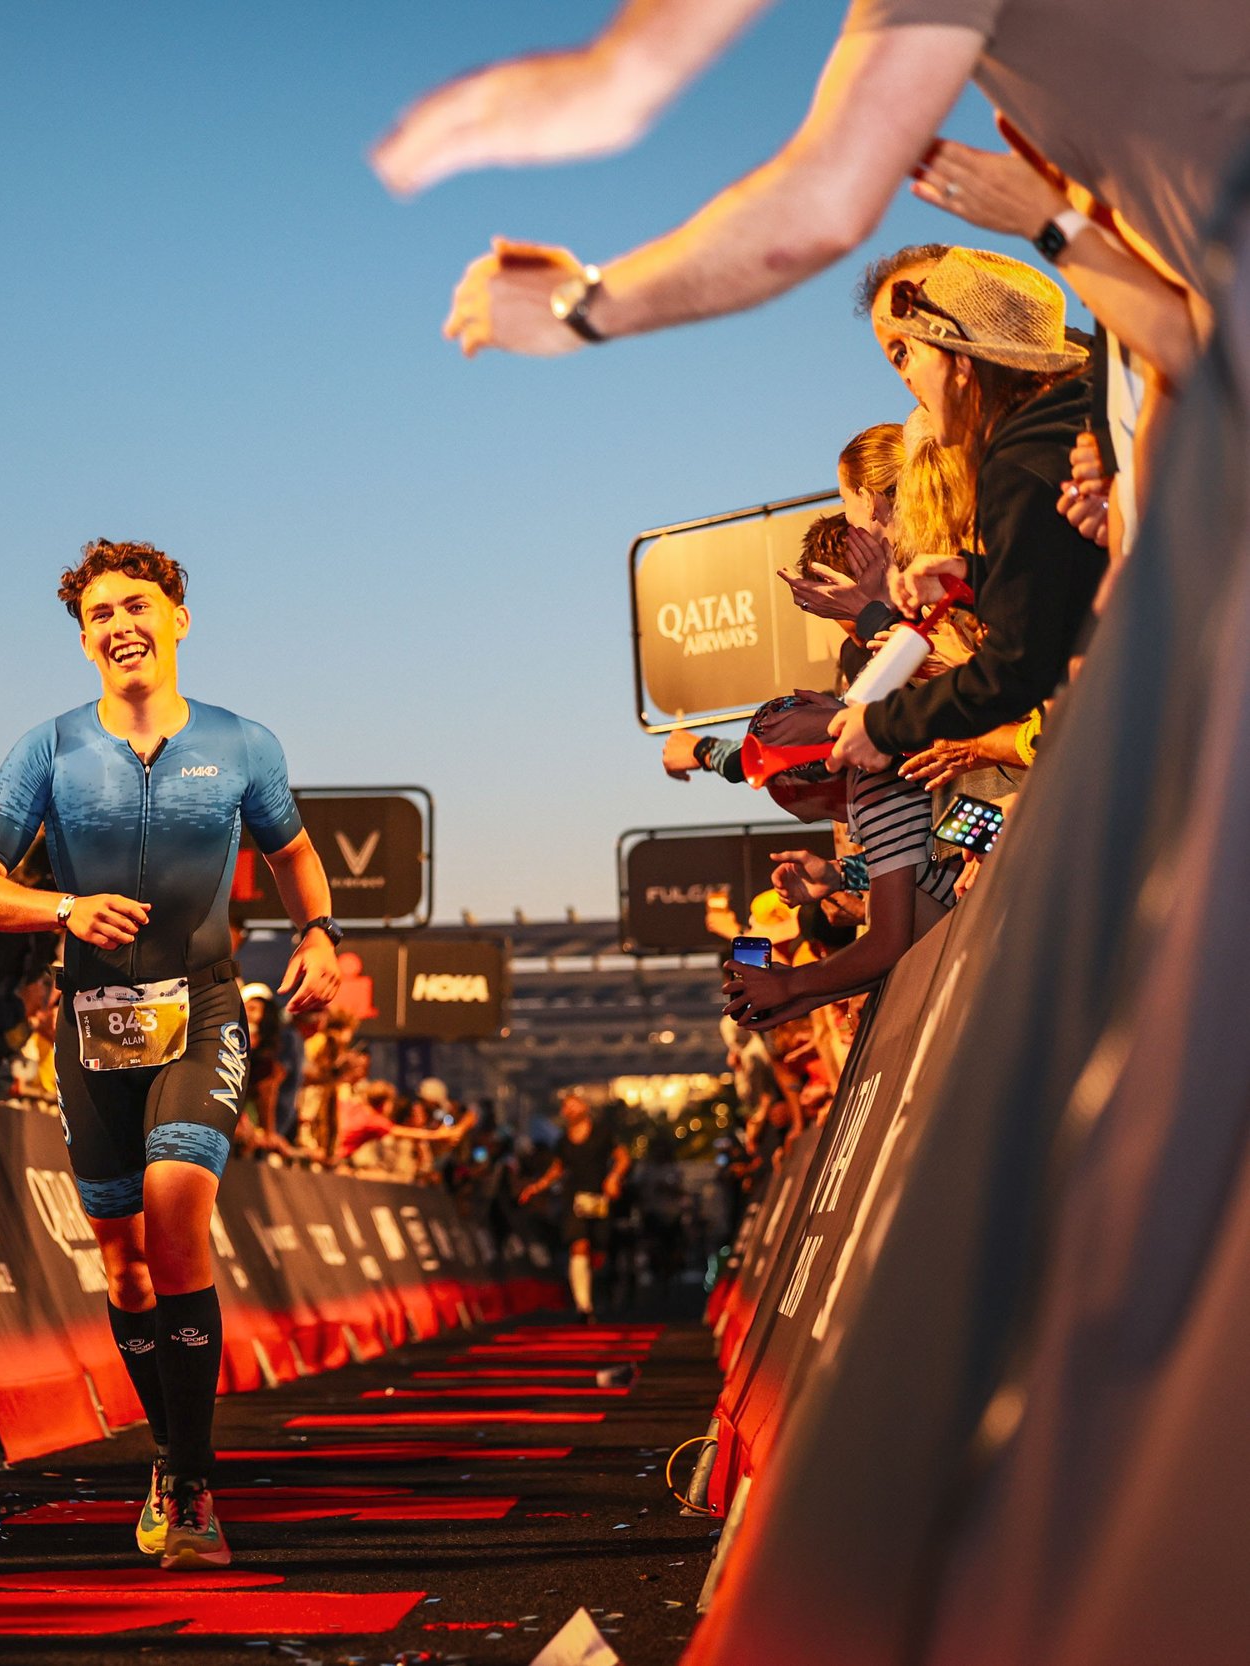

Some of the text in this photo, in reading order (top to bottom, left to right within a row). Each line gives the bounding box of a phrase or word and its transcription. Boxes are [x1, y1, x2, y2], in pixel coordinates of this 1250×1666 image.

[657, 589, 756, 643] QATAR
[683, 623, 758, 657] AIRWAYS
[108, 1009, 158, 1035] 843
[122, 1035, 145, 1046] ALAN
